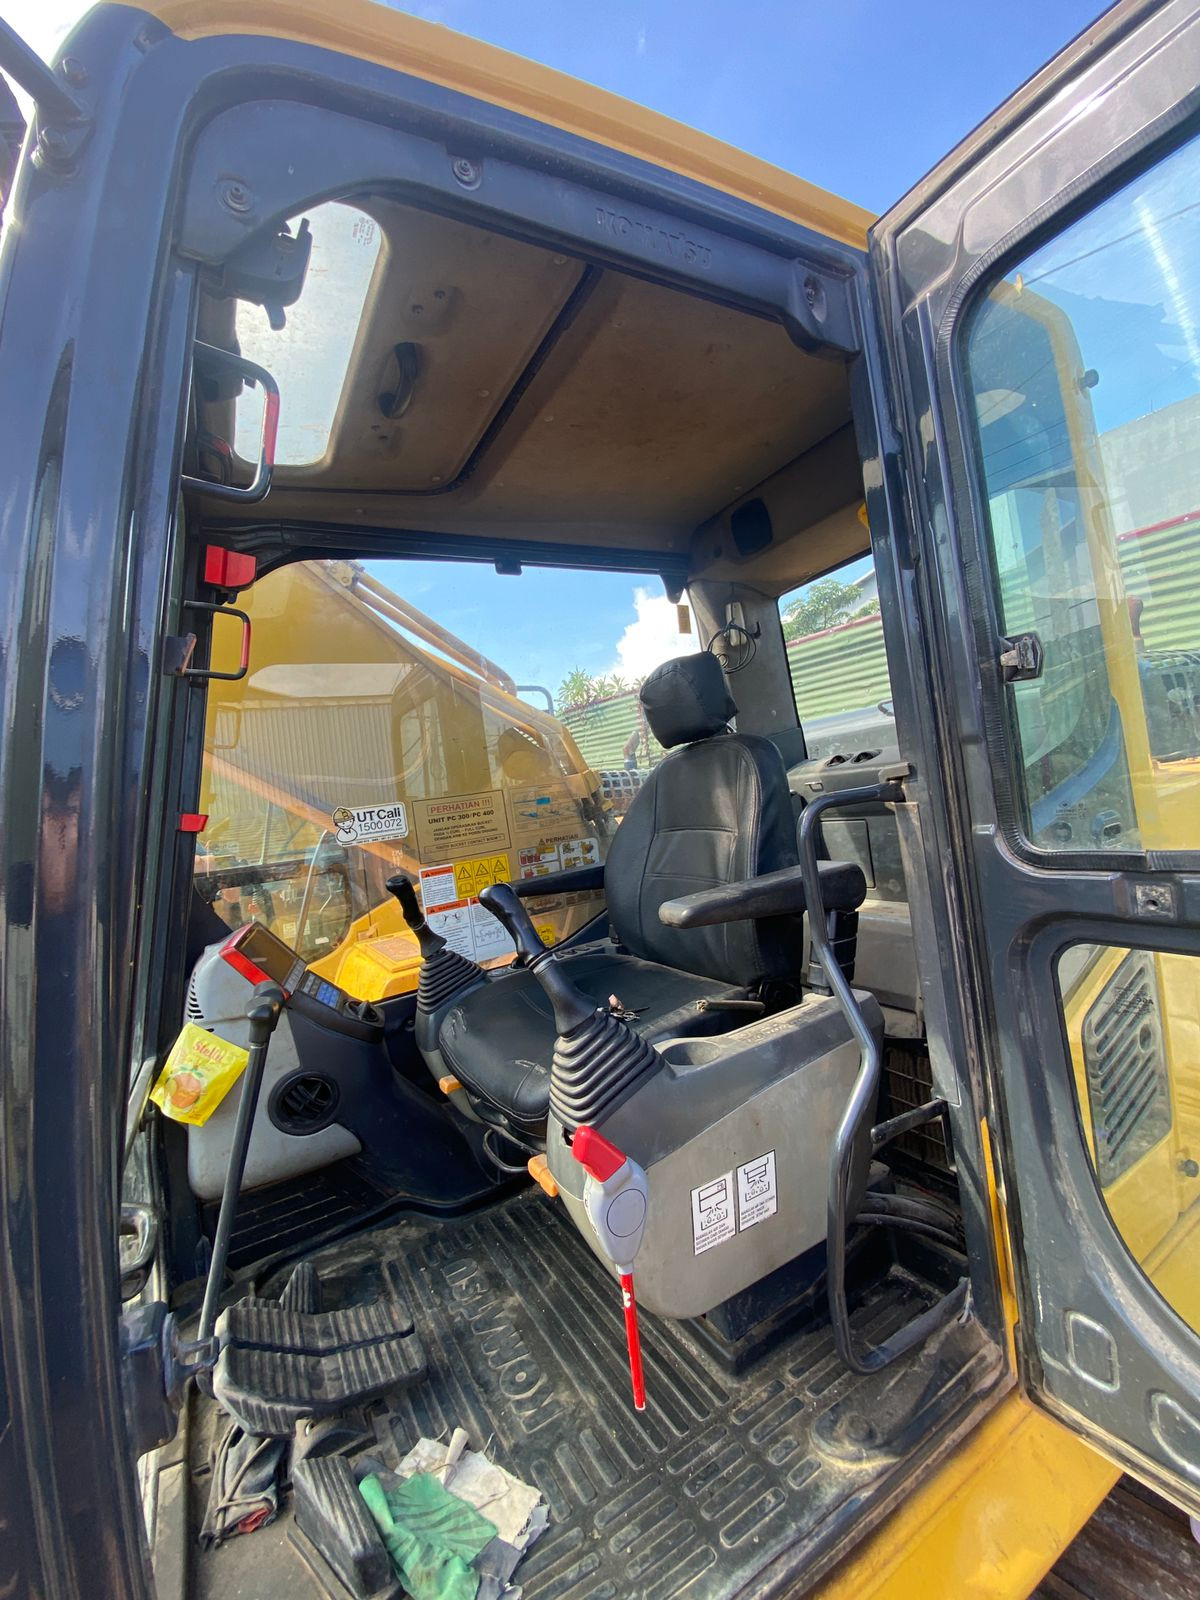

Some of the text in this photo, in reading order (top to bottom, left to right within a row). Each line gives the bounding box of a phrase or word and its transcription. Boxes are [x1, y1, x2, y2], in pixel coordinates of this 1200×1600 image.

[430, 800, 480, 814] PERHATIAN
[357, 811, 376, 822] UT
[428, 816, 445, 824] UNIT
[358, 820, 382, 832] 1500
[384, 818, 402, 829] 072
[442, 1257, 568, 1434] KOMATSU
